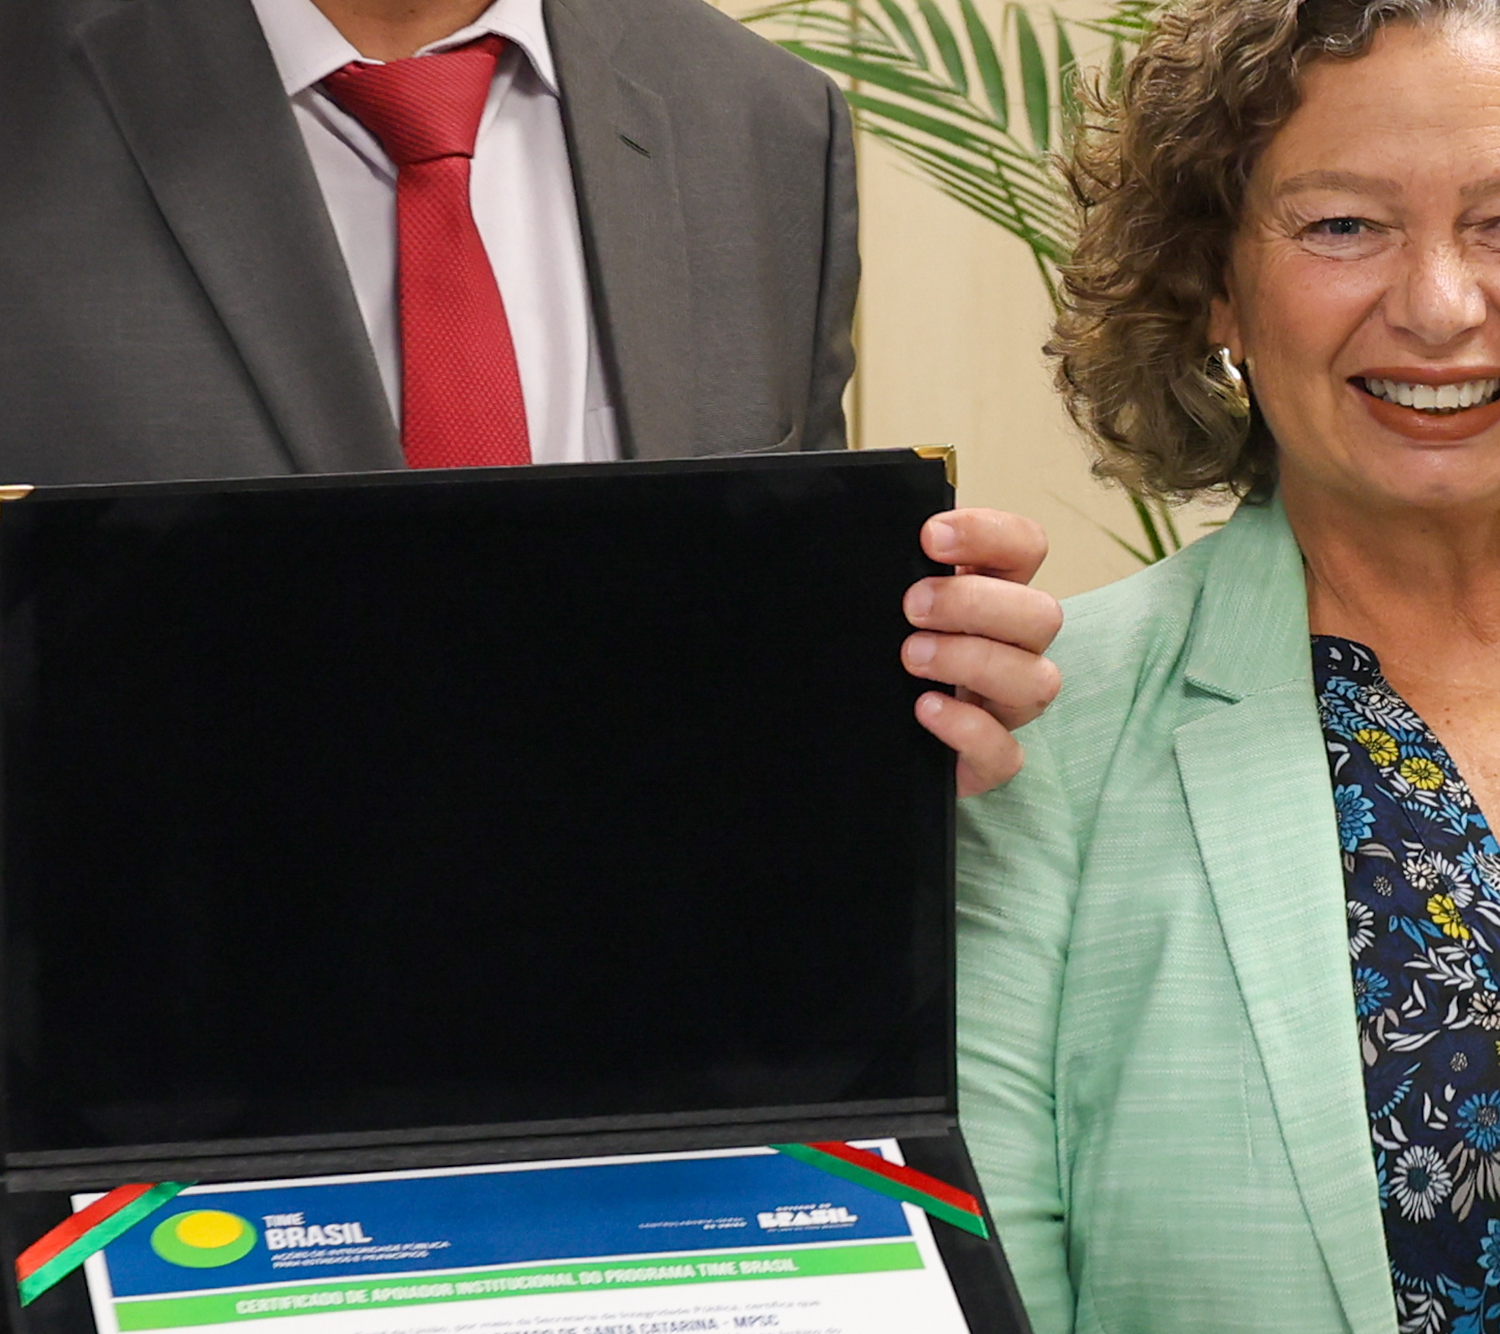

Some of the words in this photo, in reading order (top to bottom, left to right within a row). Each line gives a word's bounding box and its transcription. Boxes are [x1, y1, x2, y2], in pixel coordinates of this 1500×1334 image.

[262, 1212, 306, 1228] TIME
[265, 1222, 373, 1250] BRASIL
[235, 1291, 345, 1314] CERTIFICADO
[344, 1289, 369, 1304] DE
[371, 1282, 455, 1302] APOIADOR
[455, 1273, 579, 1295] INSTITUCIONAL
[578, 1270, 604, 1285] DO
[603, 1264, 696, 1283] PROGRAMA
[696, 1261, 739, 1277] TIME
[738, 1258, 799, 1274] BRASIL
[639, 1318, 717, 1334] CATARINA
[733, 1314, 779, 1328] MPSC
